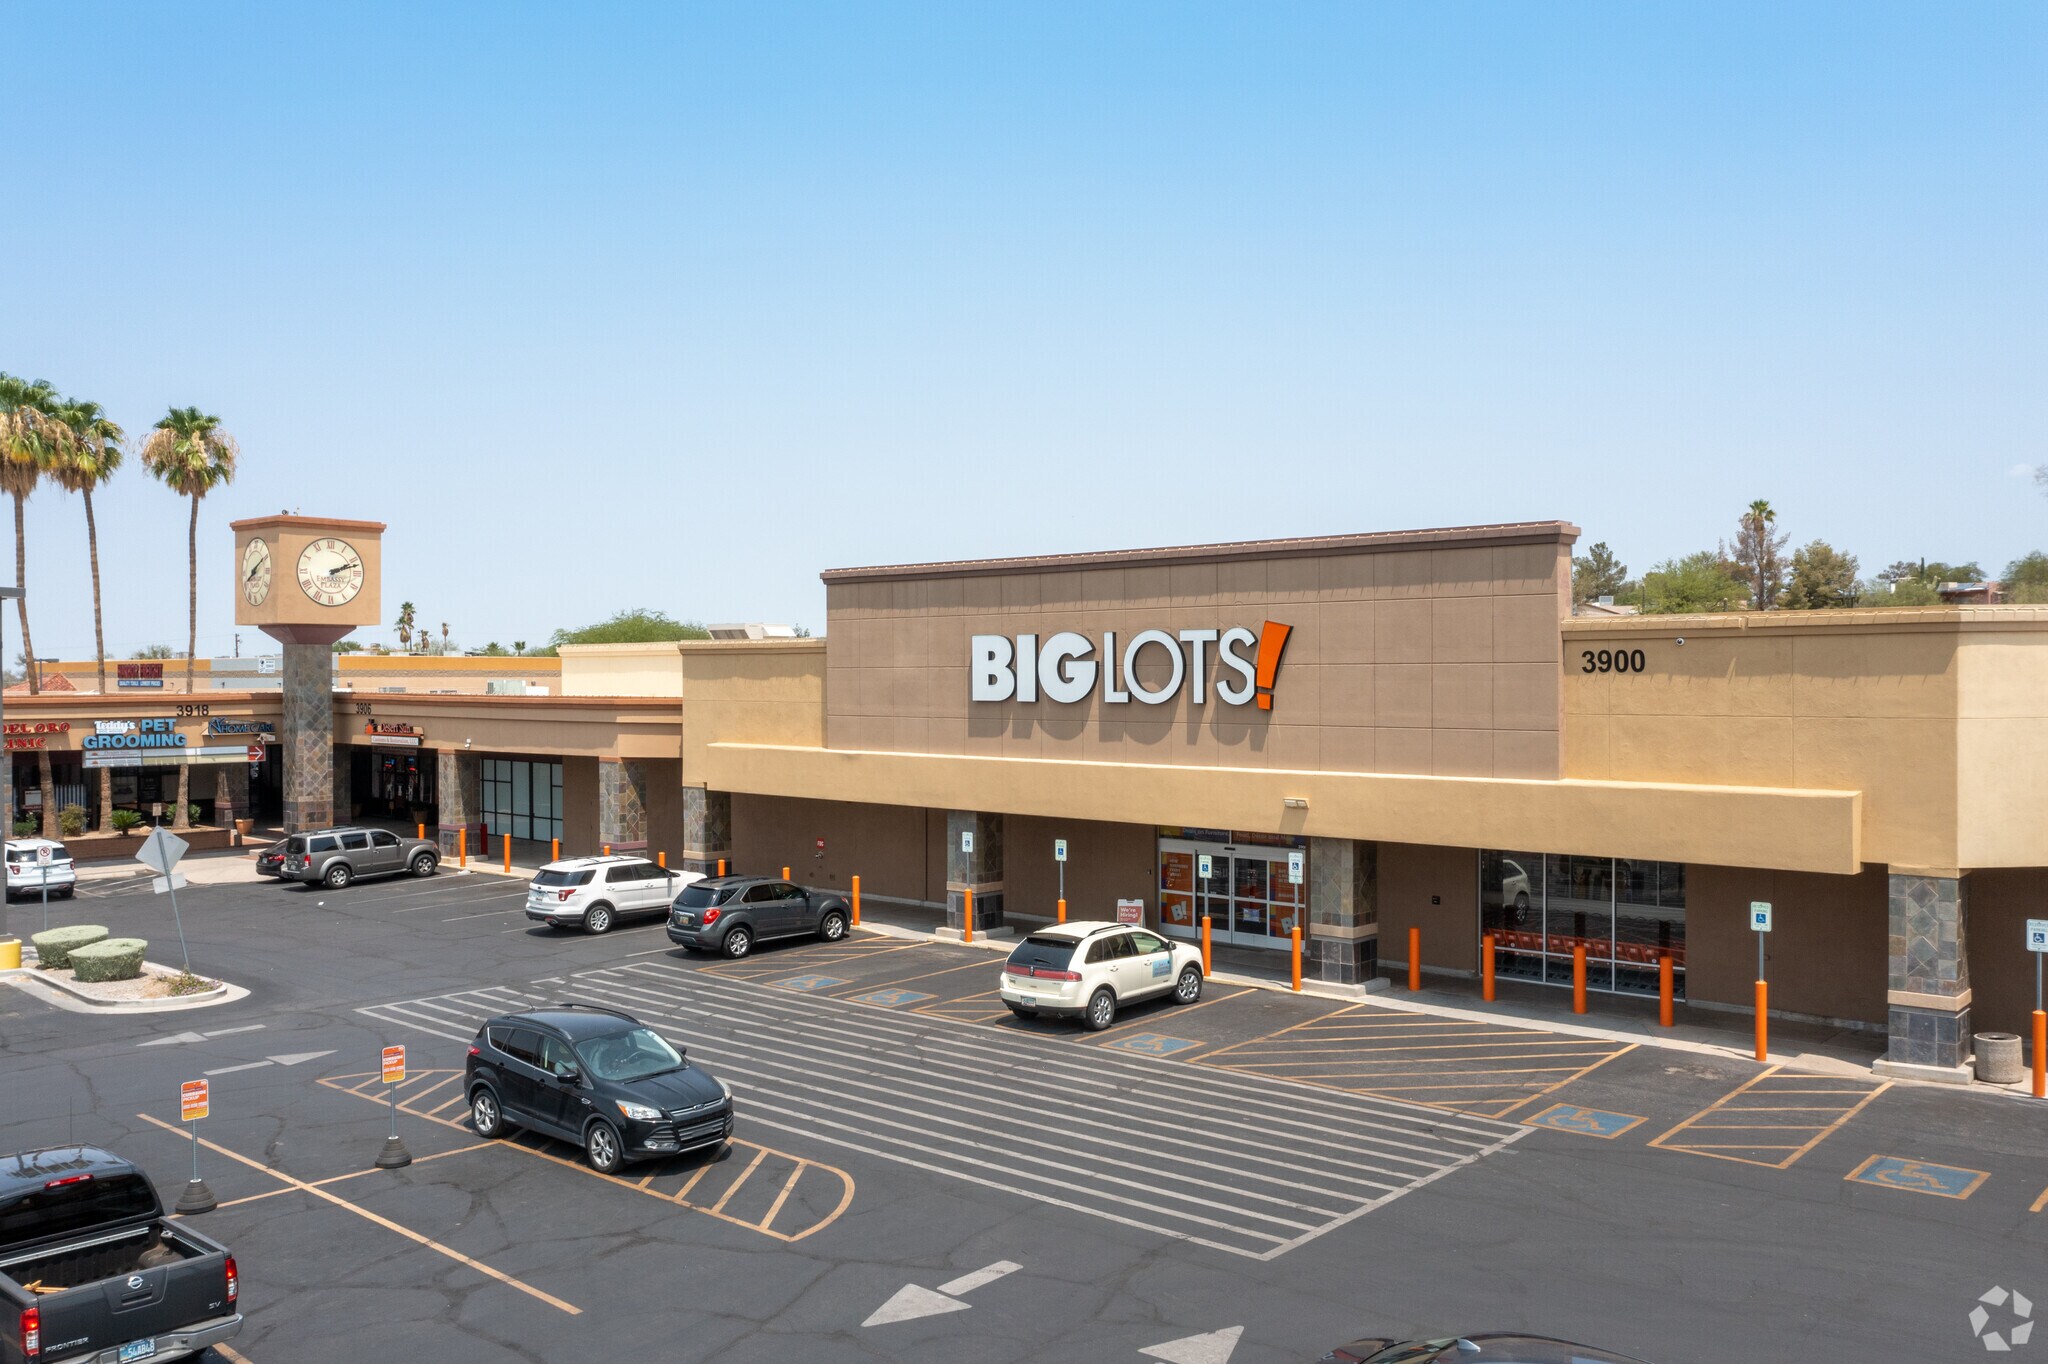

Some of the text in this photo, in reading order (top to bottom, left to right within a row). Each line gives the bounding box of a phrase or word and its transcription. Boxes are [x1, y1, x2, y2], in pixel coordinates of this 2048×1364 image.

[1581, 649, 1646, 673] 3900
[176, 704, 209, 717] 3918
[356, 703, 372, 715] 3906
[35, 722, 70, 733] ORO
[94, 718, 177, 732] Teddy's PET
[83, 733, 187, 749] GROOMING
[208, 1301, 221, 1309] SV
[45, 1336, 89, 1353] FRONTIER
